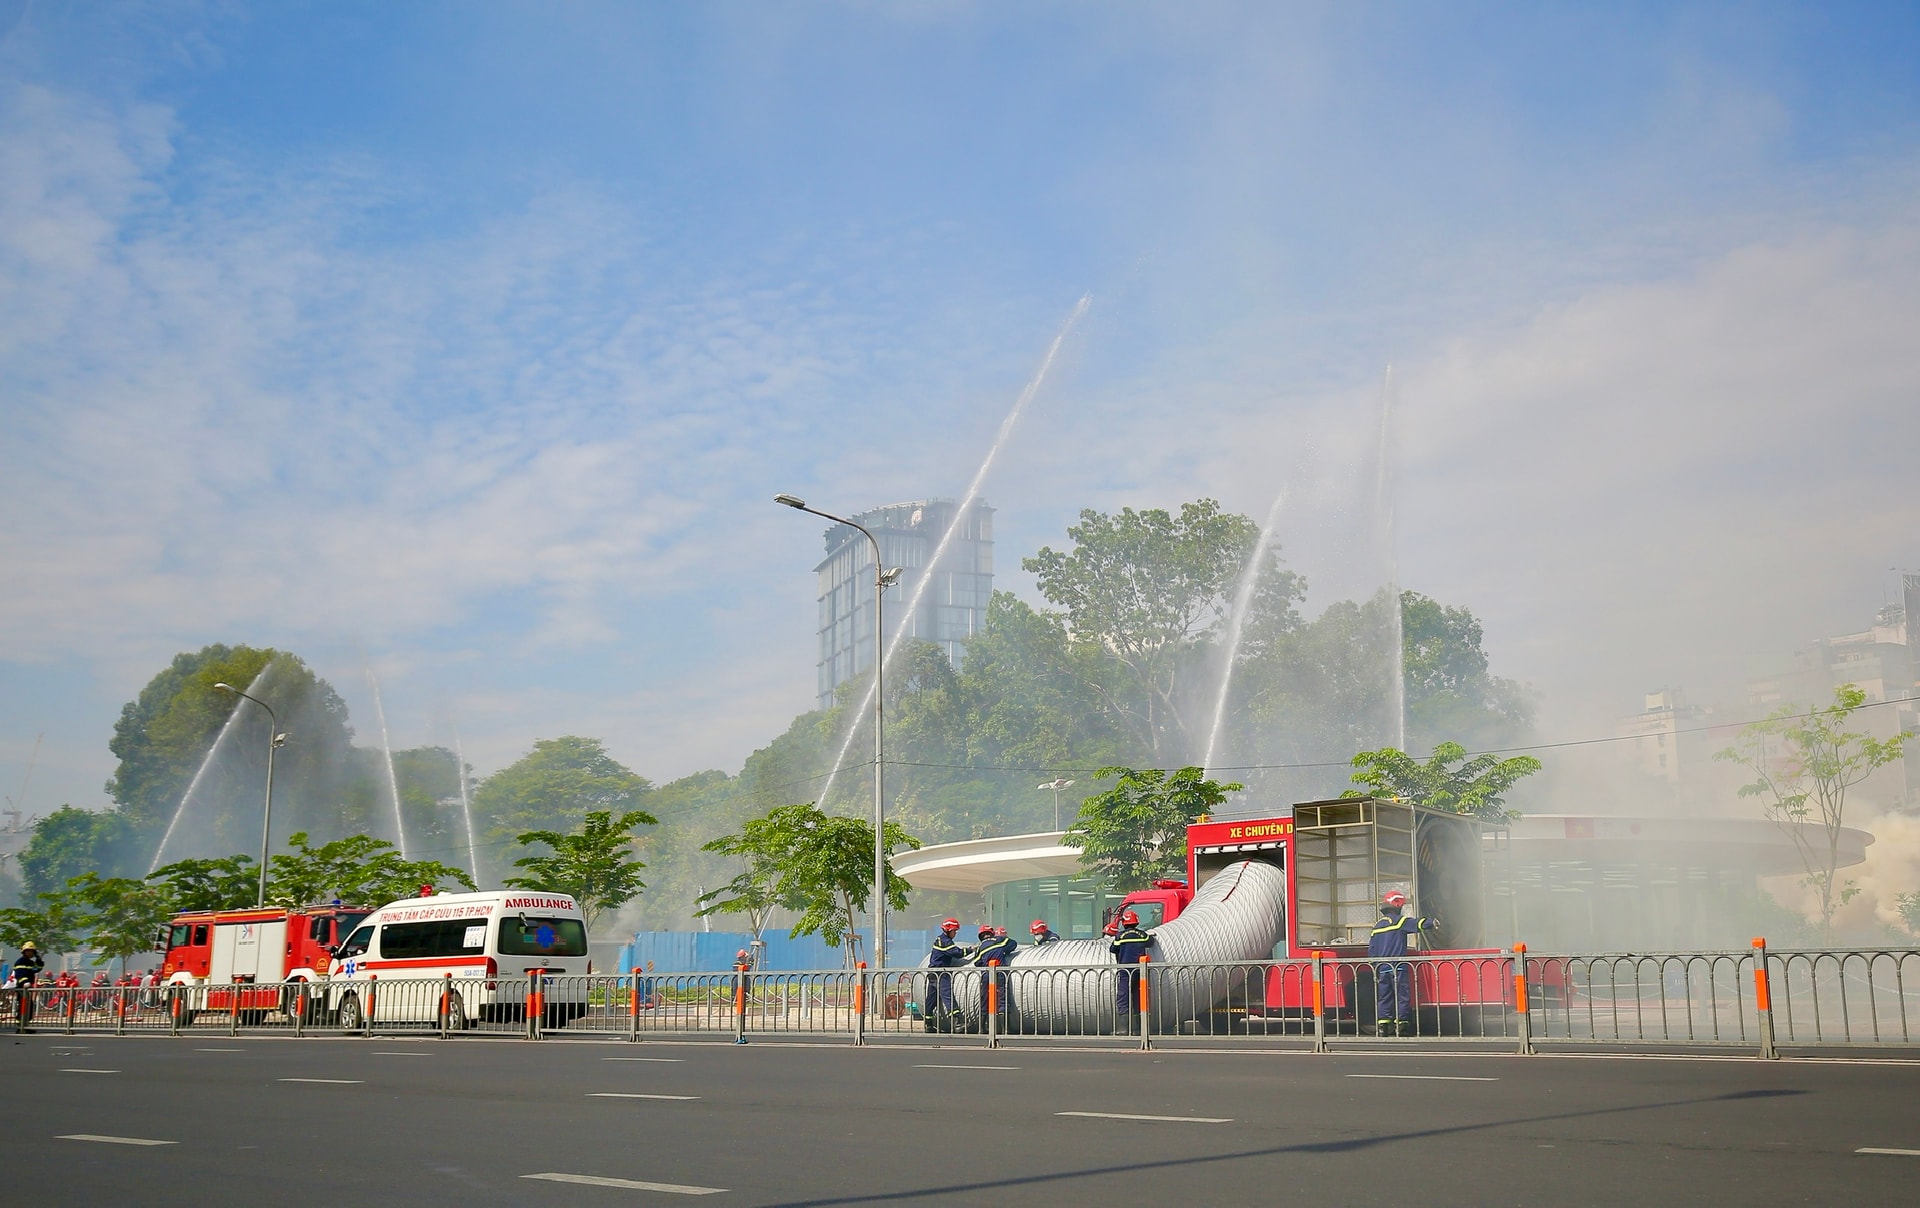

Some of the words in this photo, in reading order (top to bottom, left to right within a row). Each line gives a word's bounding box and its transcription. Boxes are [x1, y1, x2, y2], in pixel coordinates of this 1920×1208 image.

[1230, 827, 1242, 838] XE
[1245, 823, 1284, 837] CHUYÊN
[505, 898, 574, 911] AMBULANCE
[379, 911, 403, 922] TRUNG
[403, 909, 419, 920] TÂM
[419, 906, 435, 919] CẤP
[452, 907, 465, 918] 115
[465, 905, 494, 917] TP.HCM
